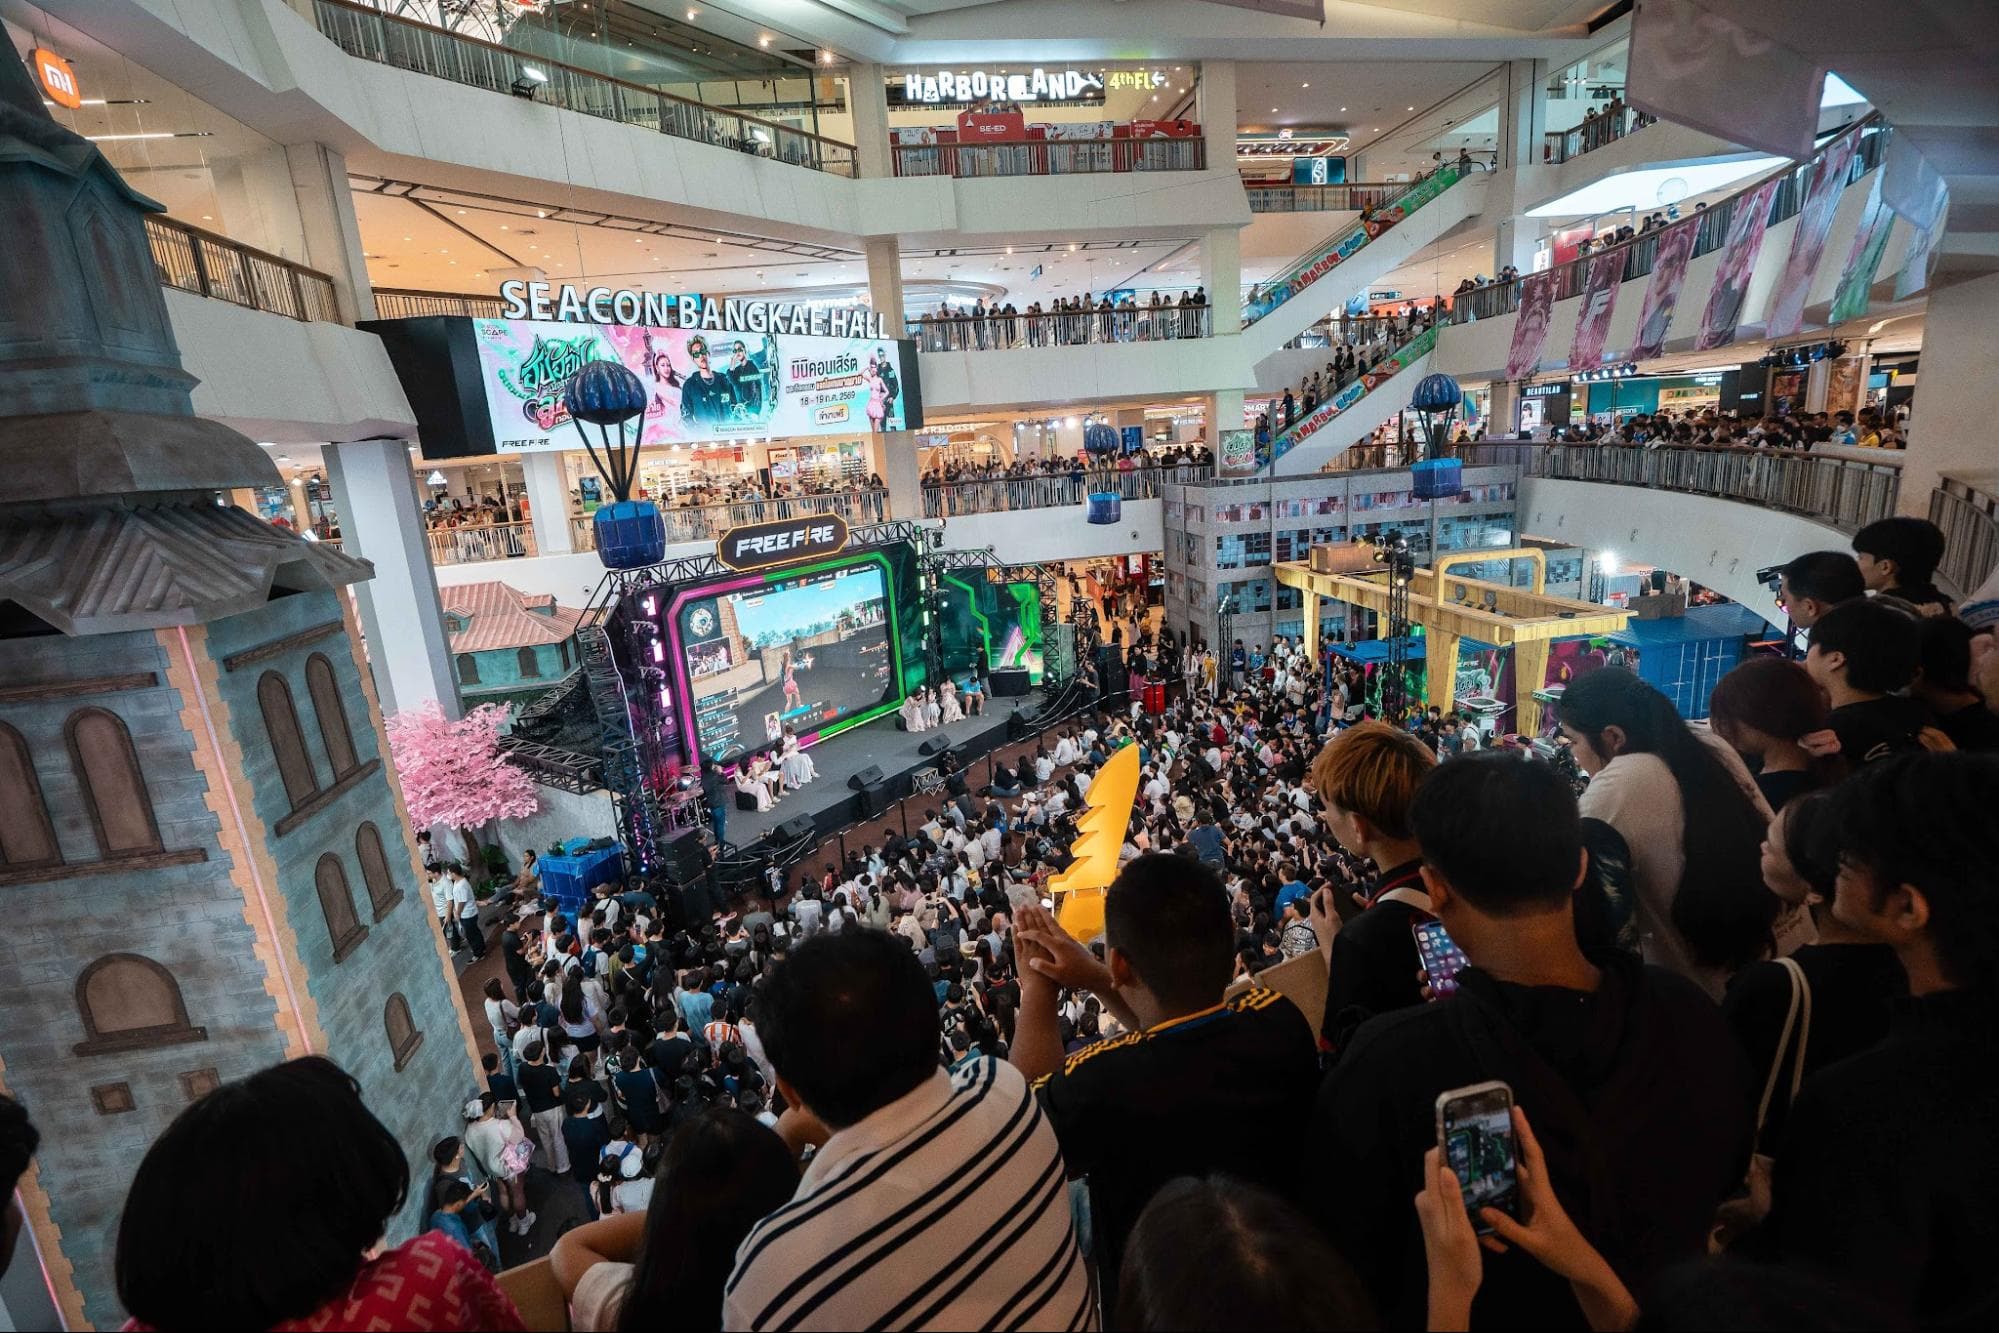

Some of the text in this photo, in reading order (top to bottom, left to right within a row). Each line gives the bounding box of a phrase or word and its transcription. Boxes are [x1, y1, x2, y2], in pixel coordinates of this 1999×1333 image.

[906, 68, 1083, 102] HARBORLAND
[979, 125, 1006, 133] SE-ED
[500, 279, 890, 340] SEACON BANGKAE HALL
[502, 438, 551, 448] FREE FIRE
[735, 524, 835, 558] FREE FIRE
